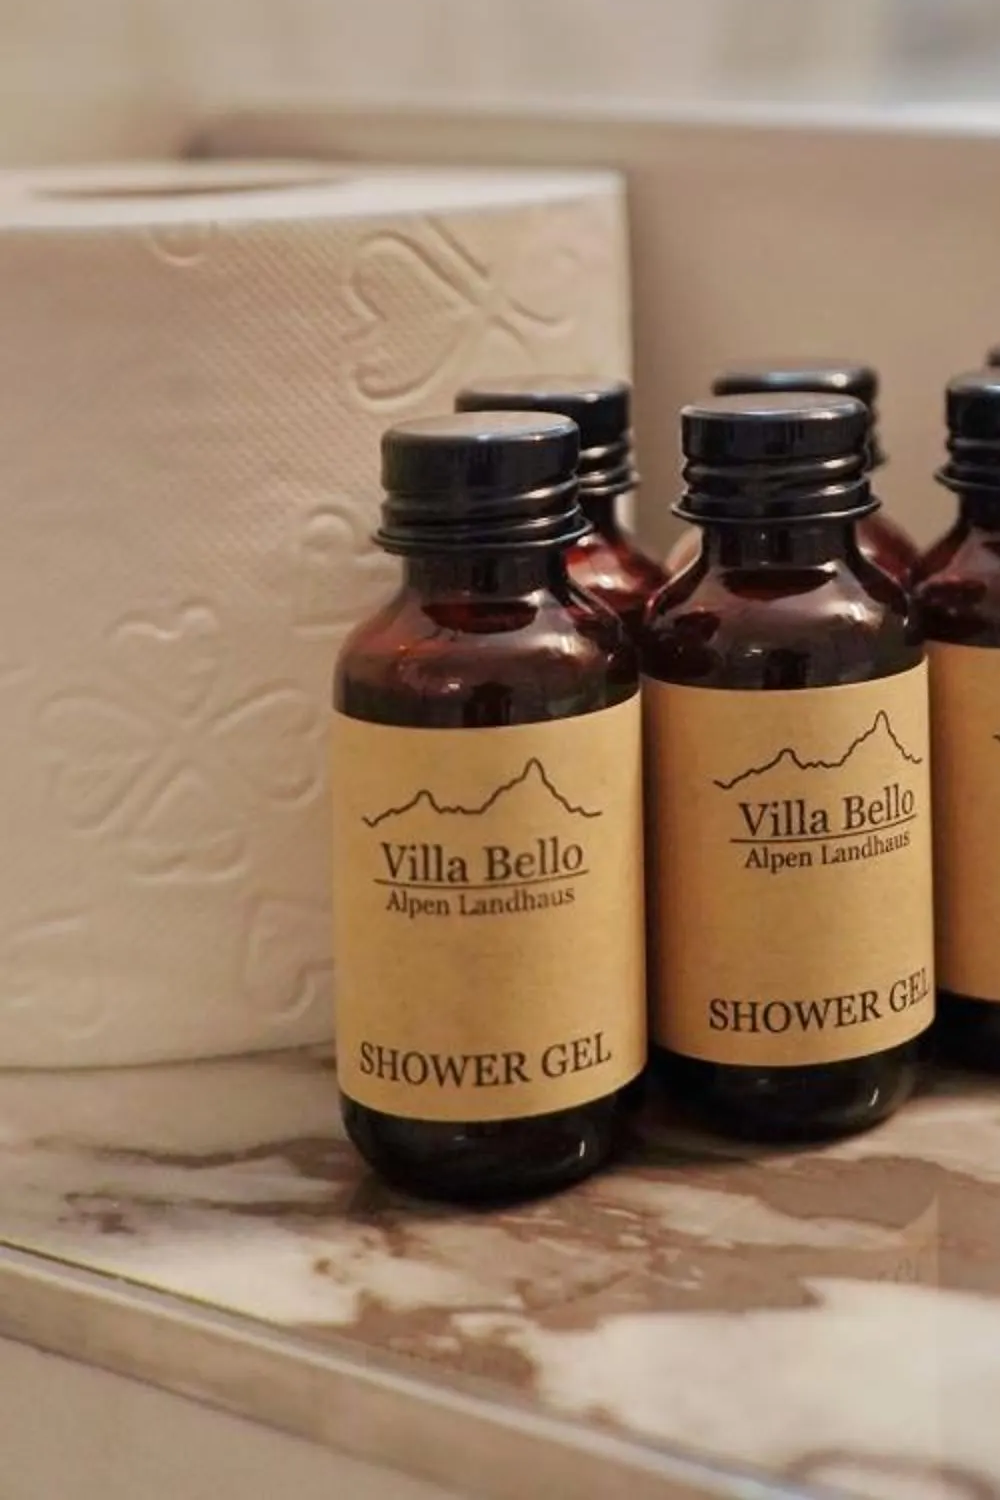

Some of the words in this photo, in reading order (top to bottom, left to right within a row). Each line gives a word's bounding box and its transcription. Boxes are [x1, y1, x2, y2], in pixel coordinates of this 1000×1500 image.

[738, 799, 830, 837] Villa
[843, 783, 914, 830] Bello
[380, 841, 469, 883] Villa
[483, 836, 583, 882] Bello
[745, 847, 813, 874] Alpen
[821, 830, 910, 865] Landhaus
[386, 891, 450, 919] Alpen
[459, 885, 576, 916] Landhaus
[709, 991, 882, 1034] SHOWER
[360, 1041, 530, 1088] SHOWER
[541, 1032, 612, 1078] GEL
